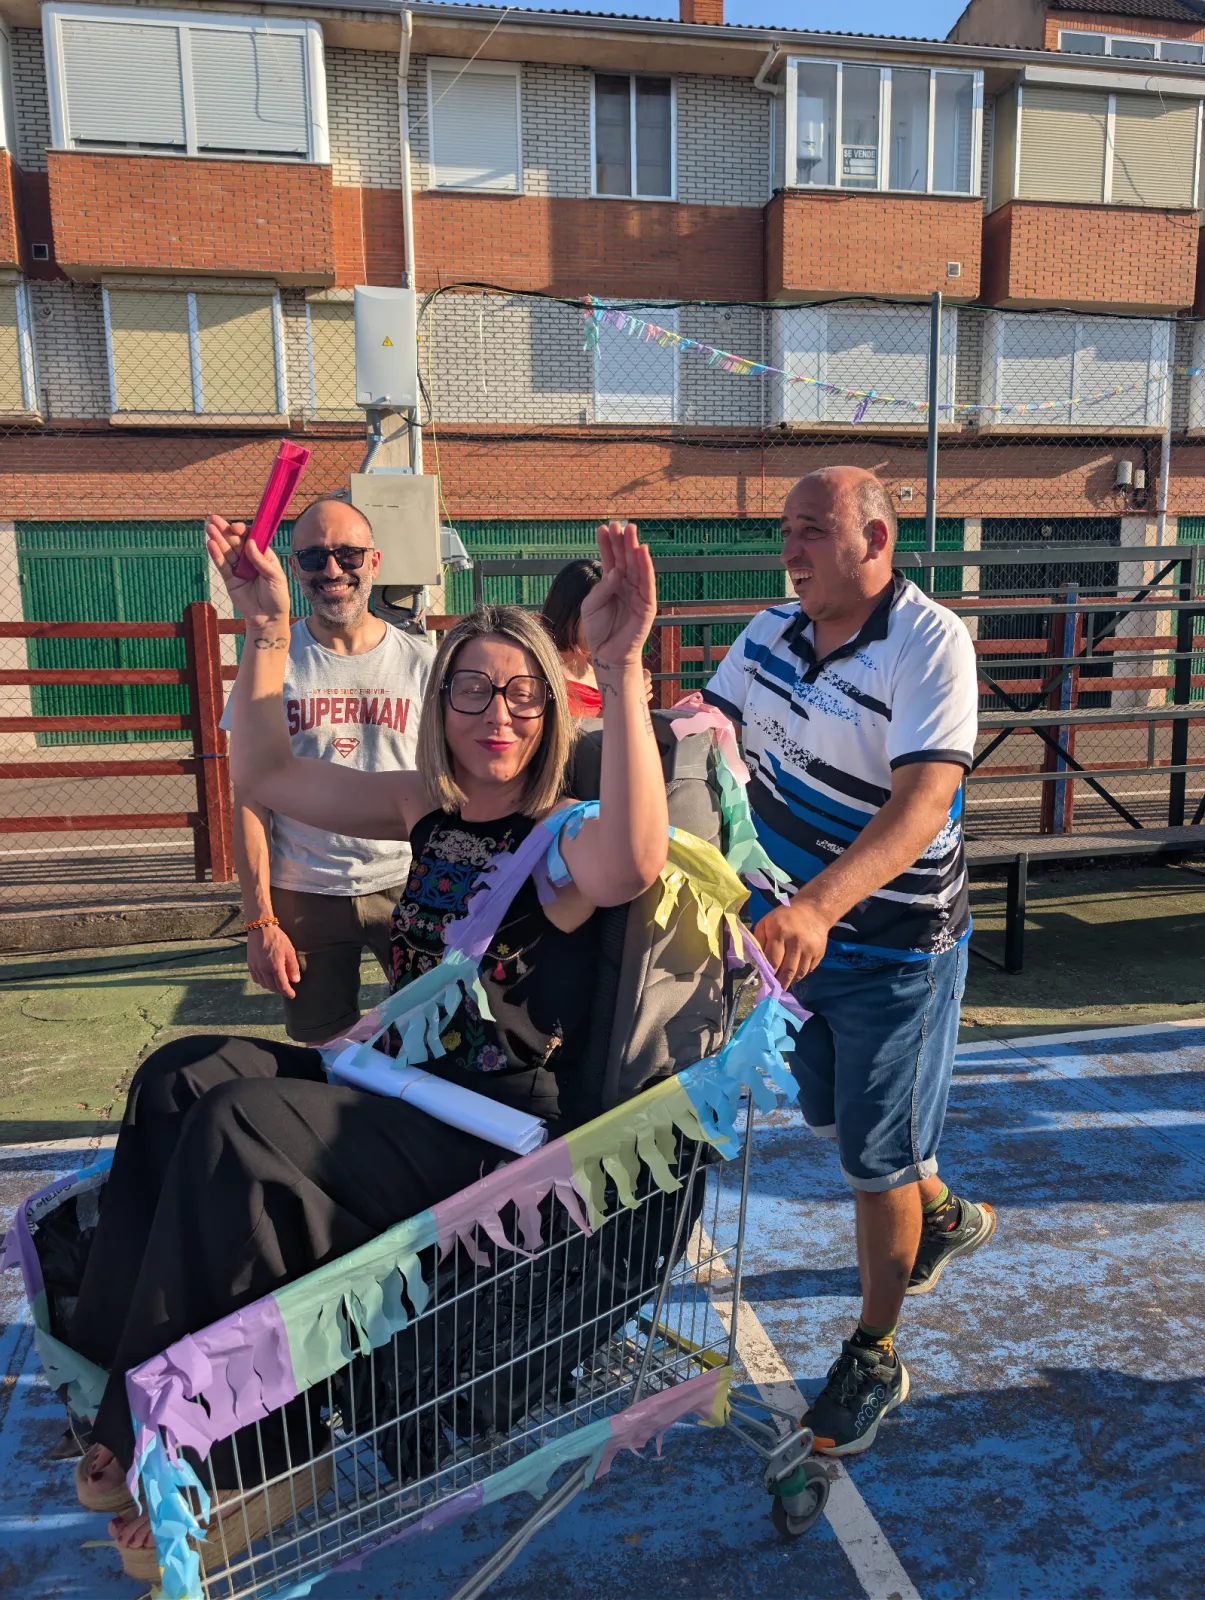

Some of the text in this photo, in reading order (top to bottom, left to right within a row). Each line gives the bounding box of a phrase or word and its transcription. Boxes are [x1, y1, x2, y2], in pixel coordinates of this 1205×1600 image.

[843, 149, 876, 159] SE VENDE
[286, 697, 411, 736] SUPERMAN
